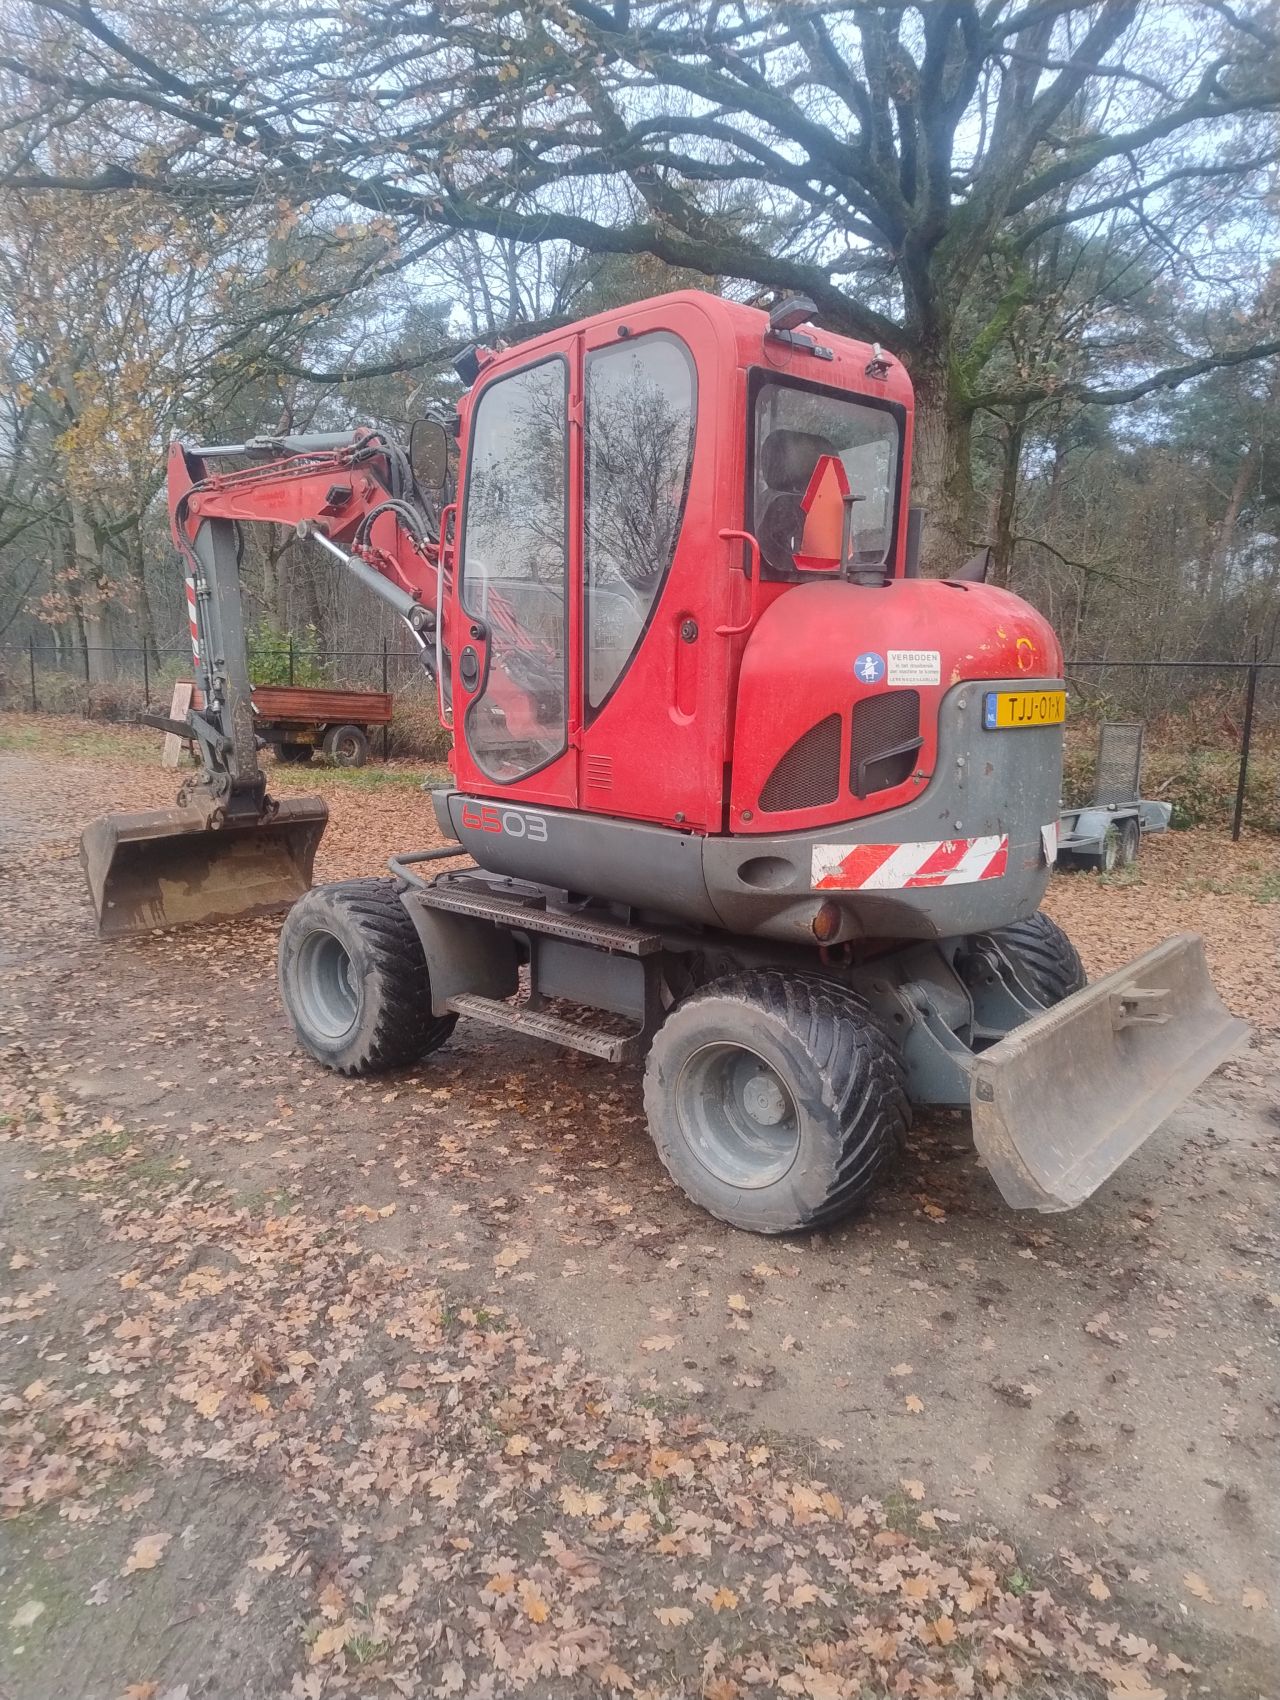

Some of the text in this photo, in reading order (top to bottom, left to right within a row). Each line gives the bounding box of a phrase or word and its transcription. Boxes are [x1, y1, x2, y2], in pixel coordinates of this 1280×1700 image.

[987, 713, 996, 722] NL
[1008, 697, 1061, 721] TJJ-01-X
[461, 803, 548, 842] 6503
